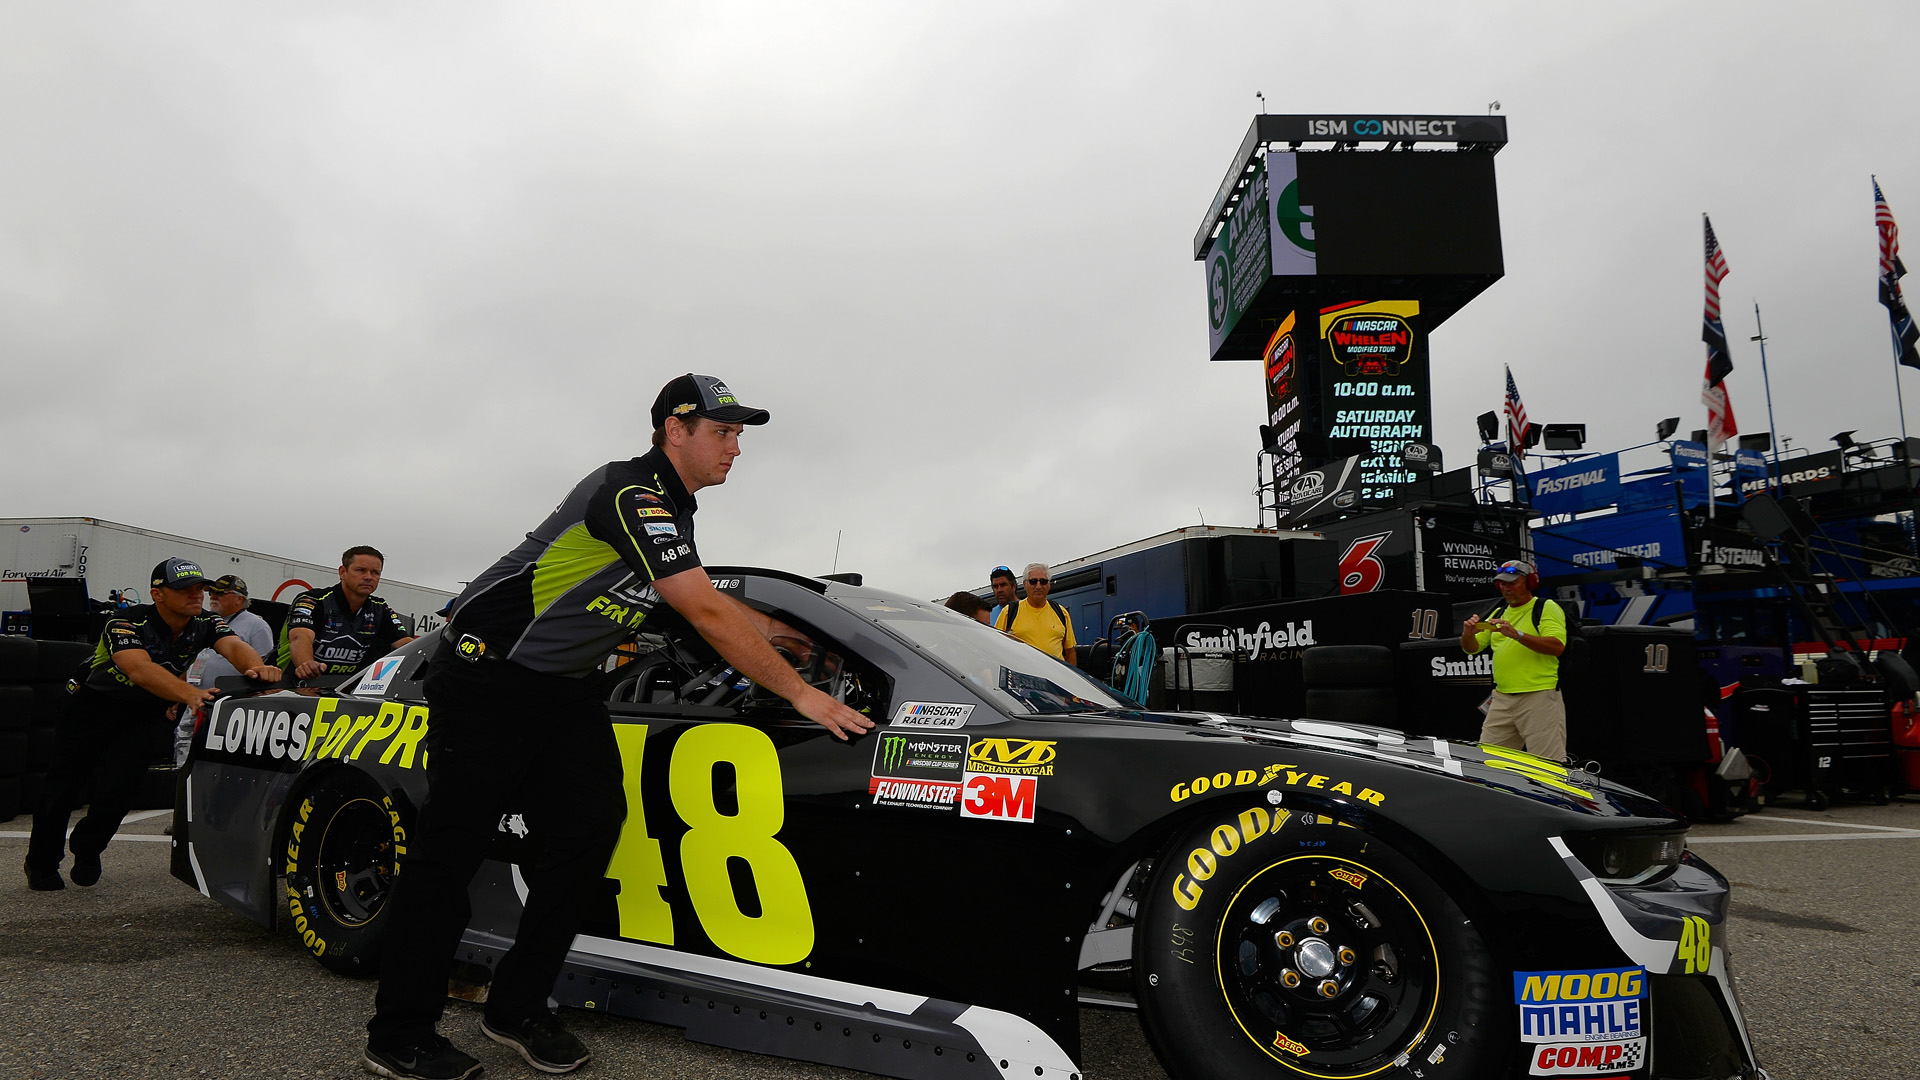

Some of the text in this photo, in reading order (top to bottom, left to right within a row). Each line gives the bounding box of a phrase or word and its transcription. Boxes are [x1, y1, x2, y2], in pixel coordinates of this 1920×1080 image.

[1308, 120, 1457, 136] ISM CONNECT
[1214, 153, 1243, 213] CONNECT
[1356, 320, 1398, 332] NASCAR
[1334, 331, 1407, 346] WHELEN
[1268, 345, 1293, 380] WHELEN
[1333, 382, 1416, 397] 10:00 a.m.
[1271, 404, 1287, 427] 10:00
[1336, 410, 1416, 423] SATURDAY
[1329, 425, 1422, 438] AUTOGRAPH
[1535, 467, 1608, 496] FASTENAL
[1742, 466, 1830, 493] MENARDS
[1291, 484, 1324, 502] ADVOCARE
[1426, 518, 1436, 529] 6
[662, 548, 677, 562] 48
[1442, 542, 1497, 555] WYNDHA
[1701, 540, 1766, 567] FSTENAL
[78, 546, 89, 578] 709
[1339, 531, 1393, 594] 6
[1444, 558, 1498, 570] REWARDS
[50, 568, 67, 578] Air
[1445, 574, 1465, 583] You've
[1466, 576, 1486, 584] earned
[586, 596, 630, 624] FOR
[416, 613, 440, 632] Air
[1408, 608, 1438, 640] 10
[314, 644, 366, 662] LOWE'S
[460, 640, 476, 654] 48
[1260, 650, 1304, 662] RACIN
[1643, 644, 1670, 673] 10
[330, 664, 356, 673] PRO
[360, 683, 384, 692] Valvoline
[918, 704, 962, 717] NASCAR
[902, 716, 956, 726] RACE CAR
[205, 696, 430, 770] LowesForPR
[966, 760, 1054, 776] MECHANIX WEAR
[1818, 756, 1832, 768] 12
[872, 781, 957, 804] FLOWMASTER
[964, 775, 1036, 820] 3M
[382, 796, 407, 877] EAGLE
[603, 723, 815, 966] 48
[1336, 871, 1362, 883] AERO
[1678, 916, 1710, 974] 48
[1520, 970, 1643, 1002] MOOG
[1522, 1002, 1639, 1036] MAHLE
[1584, 1029, 1640, 1041] ENGINE BEARINGS
[1278, 1038, 1304, 1053] AERO
[1537, 1044, 1623, 1070] COMP
[1596, 1060, 1636, 1071] CAMS
